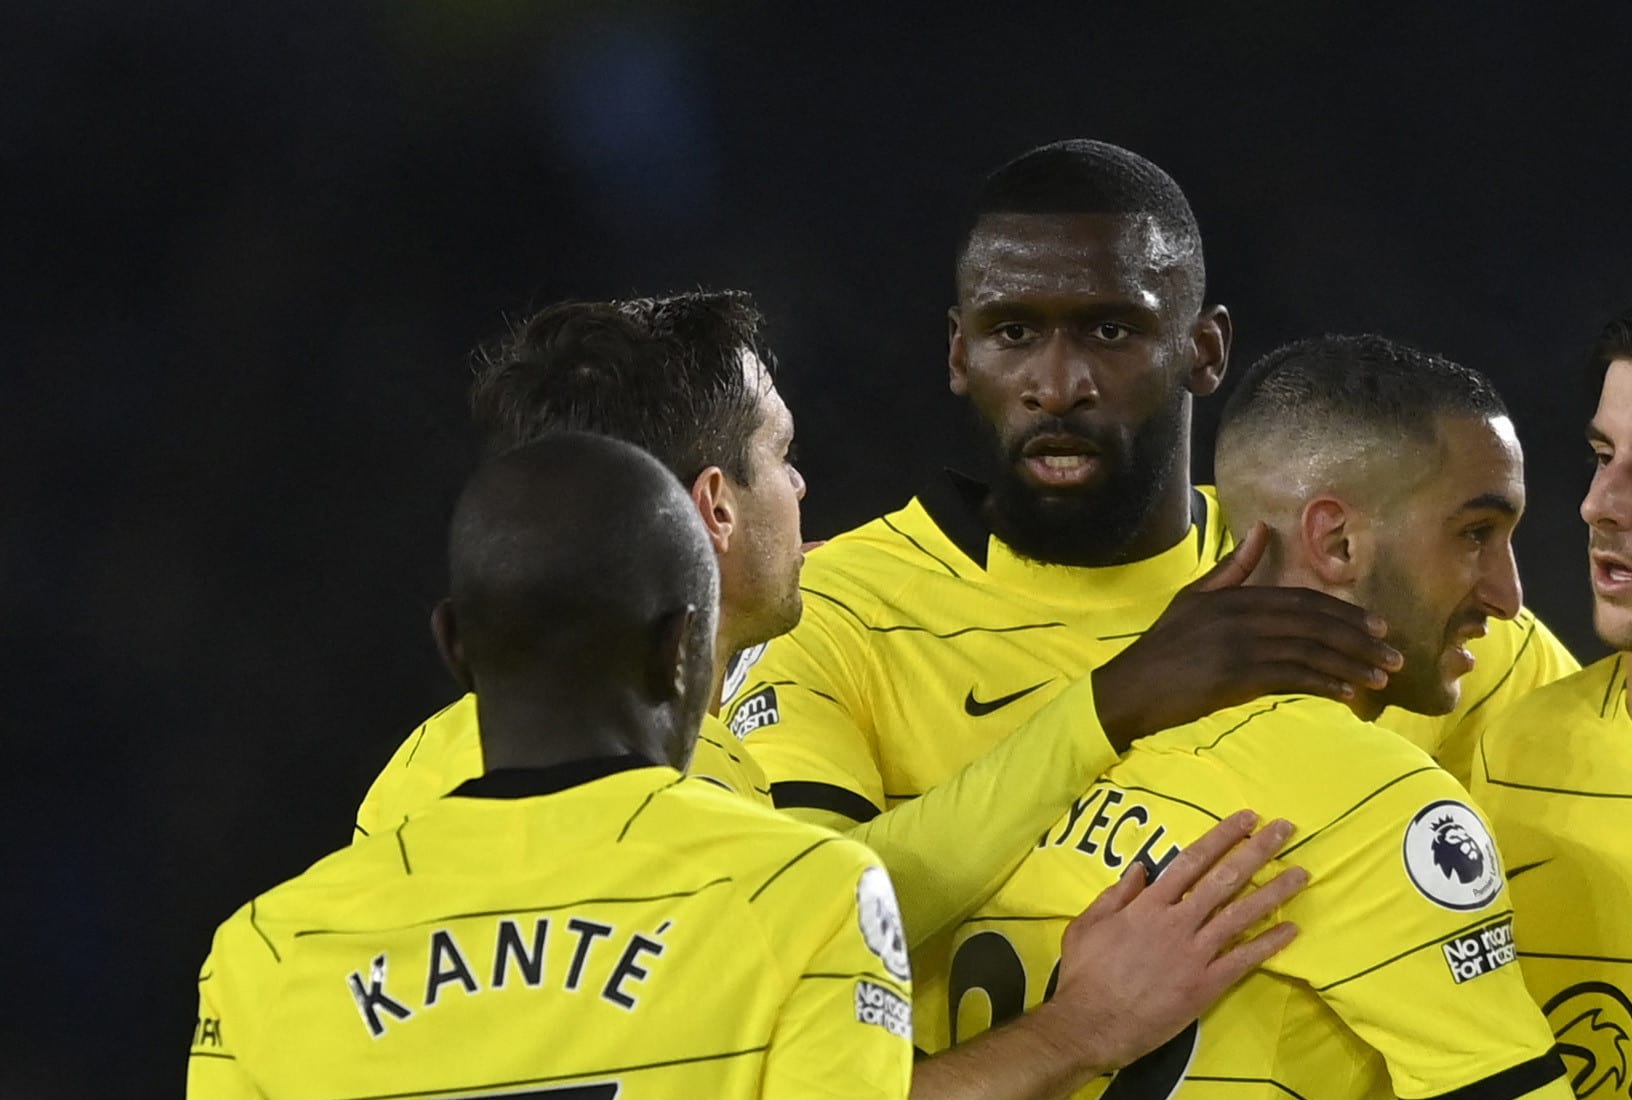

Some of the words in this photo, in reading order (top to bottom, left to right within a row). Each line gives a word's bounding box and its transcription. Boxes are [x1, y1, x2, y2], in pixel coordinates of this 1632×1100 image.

[1036, 788, 1182, 887] YECH
[1442, 938, 1480, 966] No
[347, 916, 674, 1038] KANTÉ
[1451, 955, 1483, 984] for
[856, 981, 884, 1006] No
[856, 1001, 884, 1026] for
